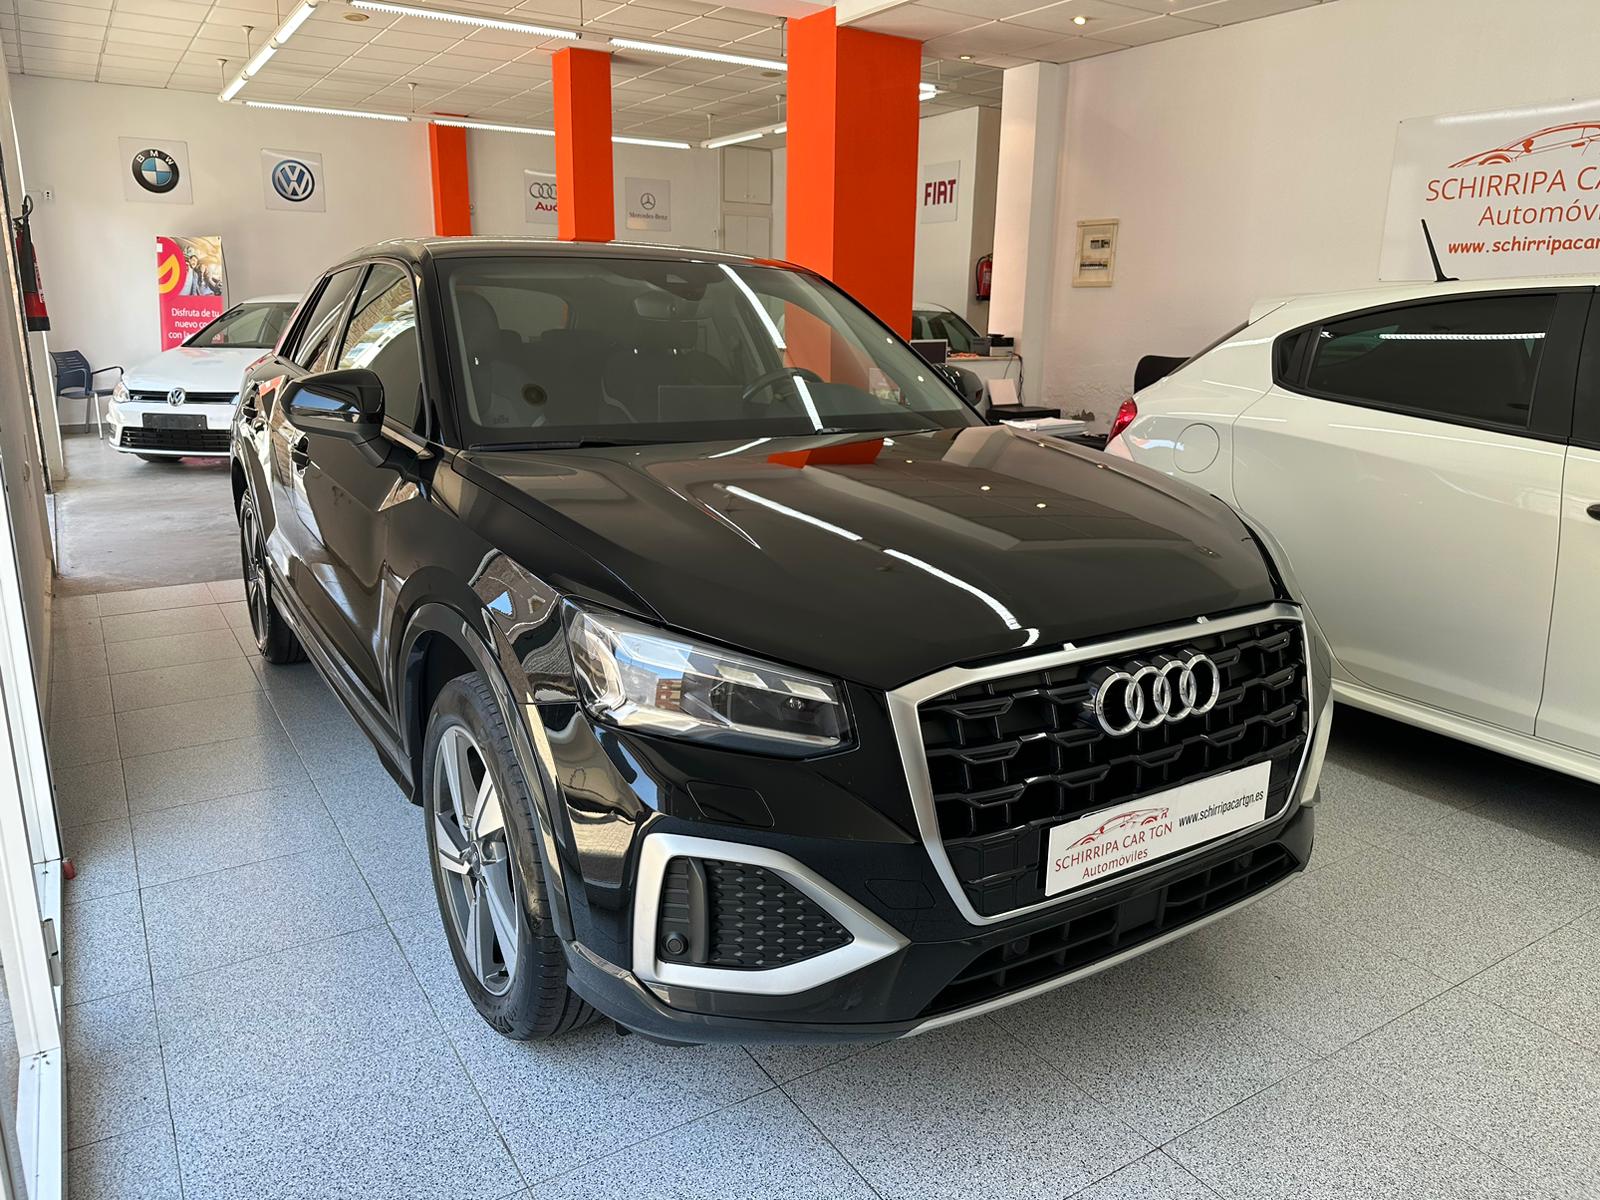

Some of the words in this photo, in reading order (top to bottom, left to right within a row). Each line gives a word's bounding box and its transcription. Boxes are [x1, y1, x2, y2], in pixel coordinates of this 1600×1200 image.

[136, 149, 175, 164] BMW
[924, 179, 956, 206] FIAT
[1426, 169, 1567, 201] SCHIRRIPA
[171, 307, 200, 317] Disfruta
[201, 308, 211, 318] de
[168, 331, 182, 339] con
[1055, 839, 1119, 872] SCHIRRIPA
[1123, 830, 1146, 848] CAR
[1150, 821, 1173, 840] TGN
